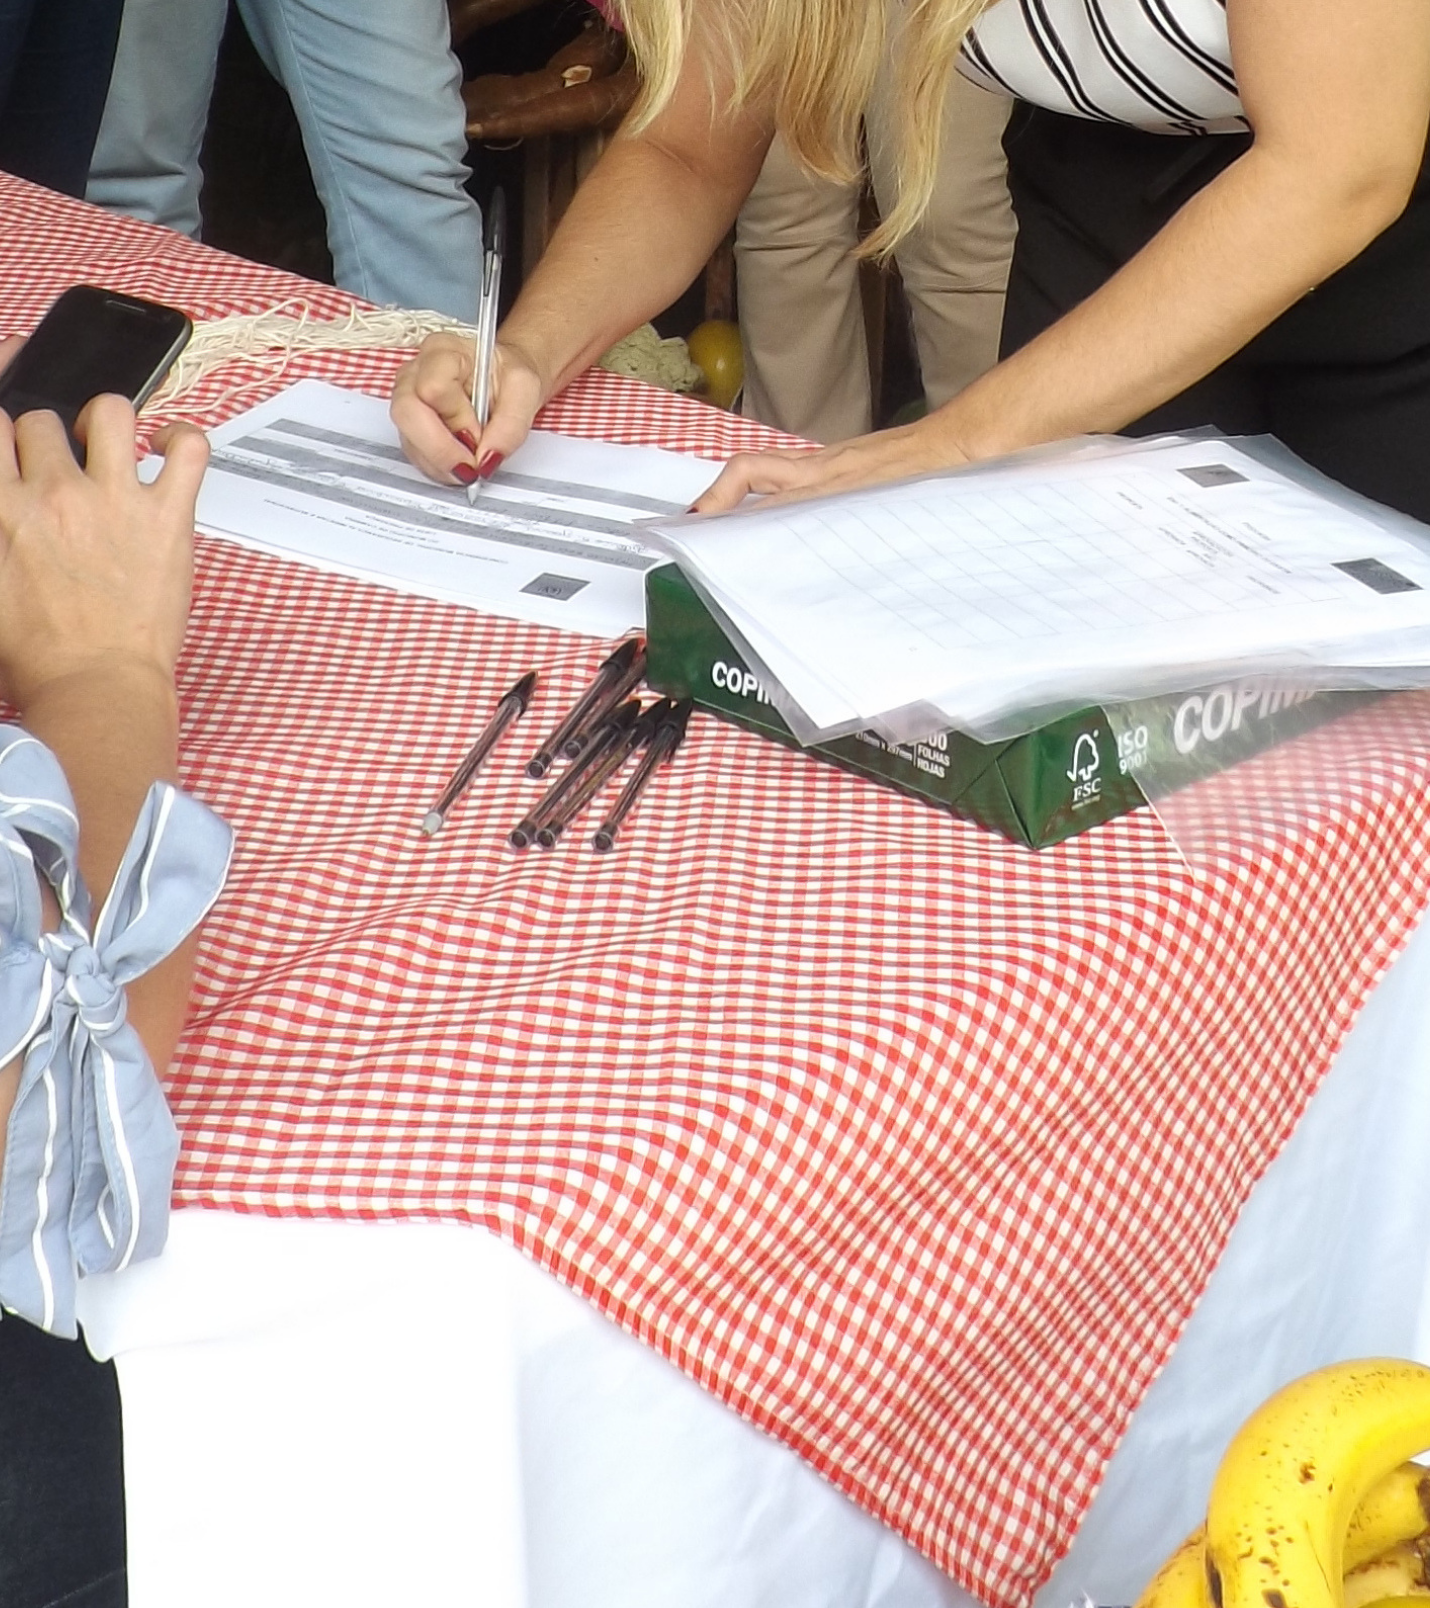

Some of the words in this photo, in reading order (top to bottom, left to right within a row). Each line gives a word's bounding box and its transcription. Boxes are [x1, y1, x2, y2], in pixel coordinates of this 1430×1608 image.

[1118, 725, 1148, 758] ISO
[917, 743, 951, 767] FOLHAS
[1073, 777, 1102, 802] FSC
